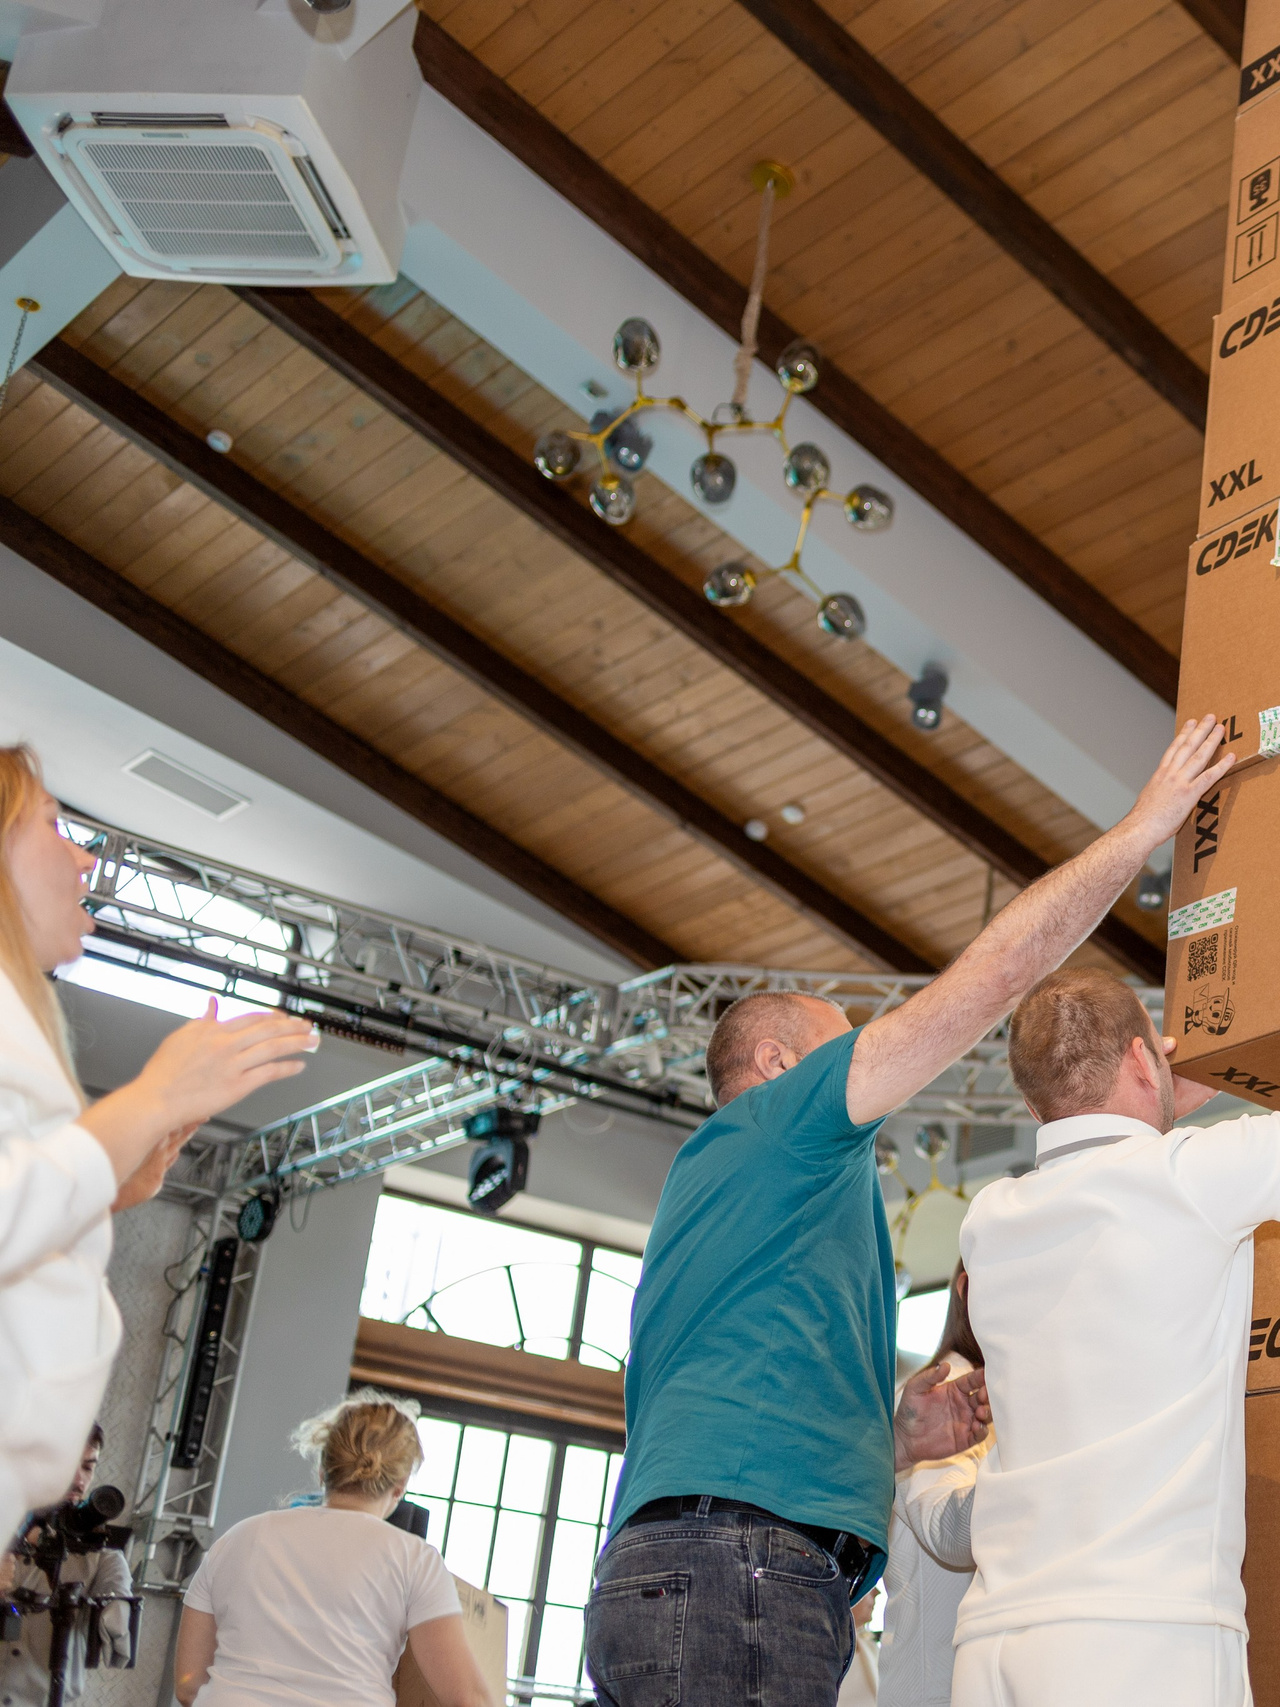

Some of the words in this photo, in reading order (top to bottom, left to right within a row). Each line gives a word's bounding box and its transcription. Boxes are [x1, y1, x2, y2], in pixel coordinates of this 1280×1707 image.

[1207, 459, 1263, 508] XXL
[1196, 508, 1279, 576] CDEK
[1193, 790, 1220, 874] XXL
